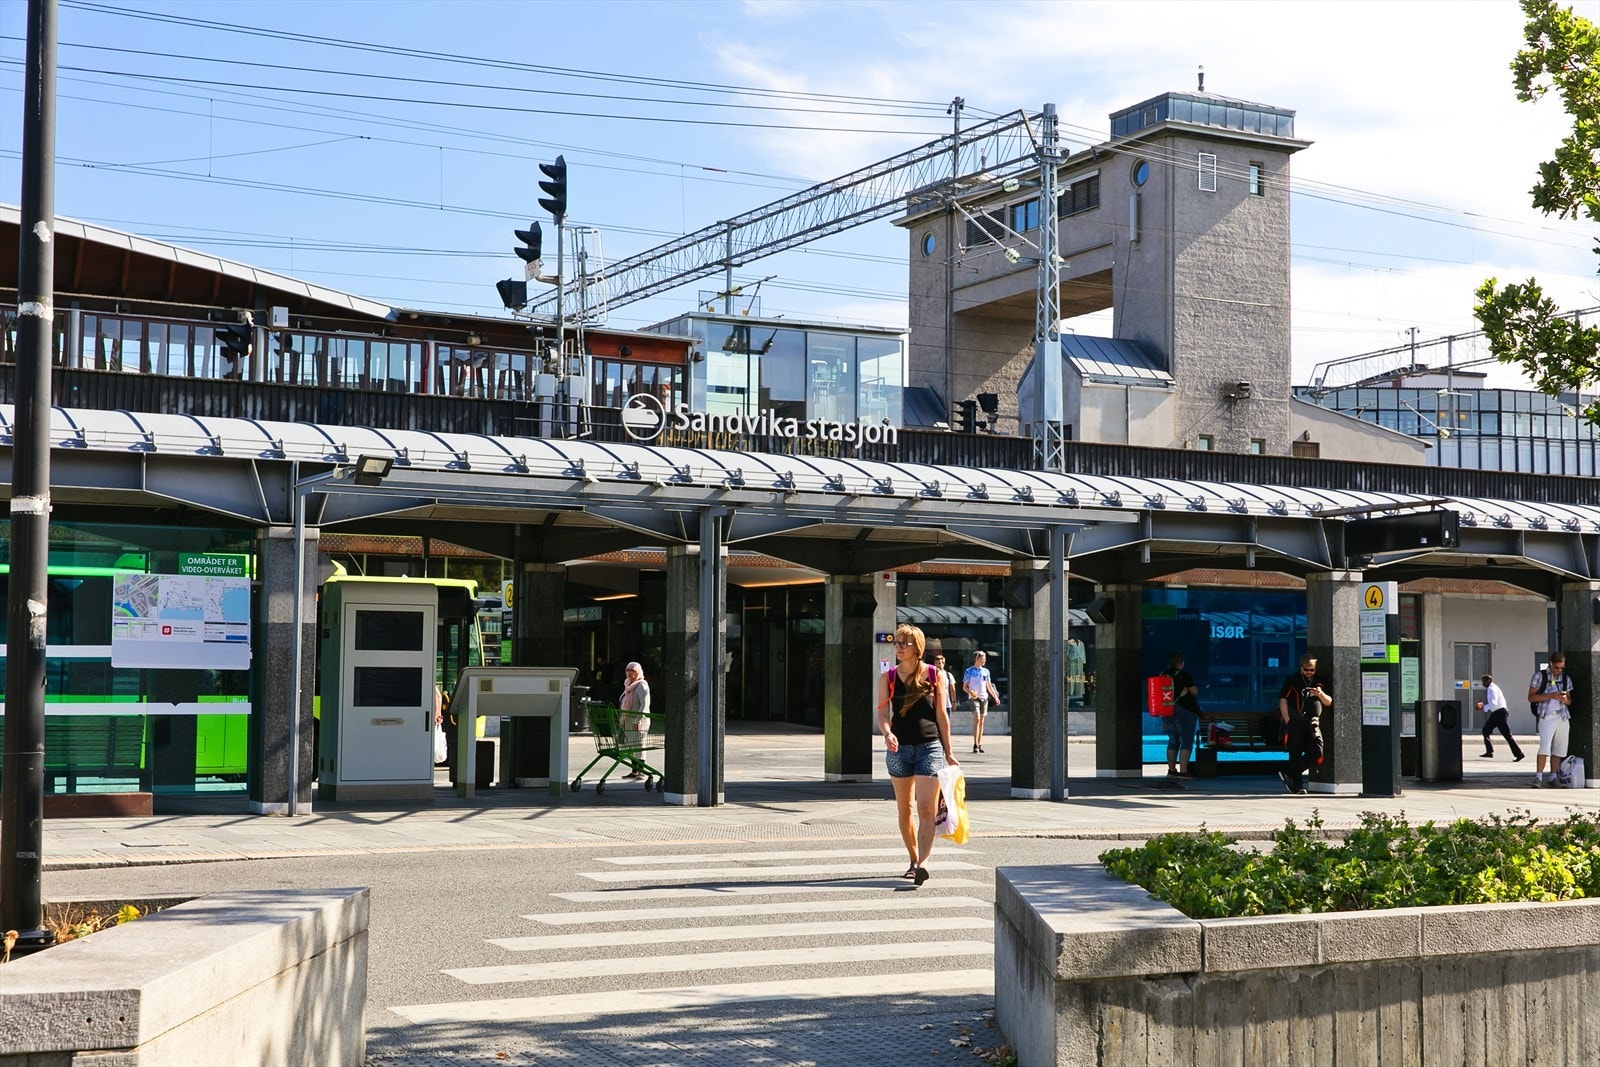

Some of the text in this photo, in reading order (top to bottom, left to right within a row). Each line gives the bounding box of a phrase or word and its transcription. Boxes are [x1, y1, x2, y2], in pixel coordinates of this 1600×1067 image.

[674, 402, 798, 438] Sandvika
[806, 417, 898, 449] stasjon
[187, 556, 237, 566] OMRÅDET ER
[181, 565, 243, 575] VIDEO-OVERVÅKET
[1369, 590, 1378, 606] 4
[1210, 625, 1244, 639] ISØR
